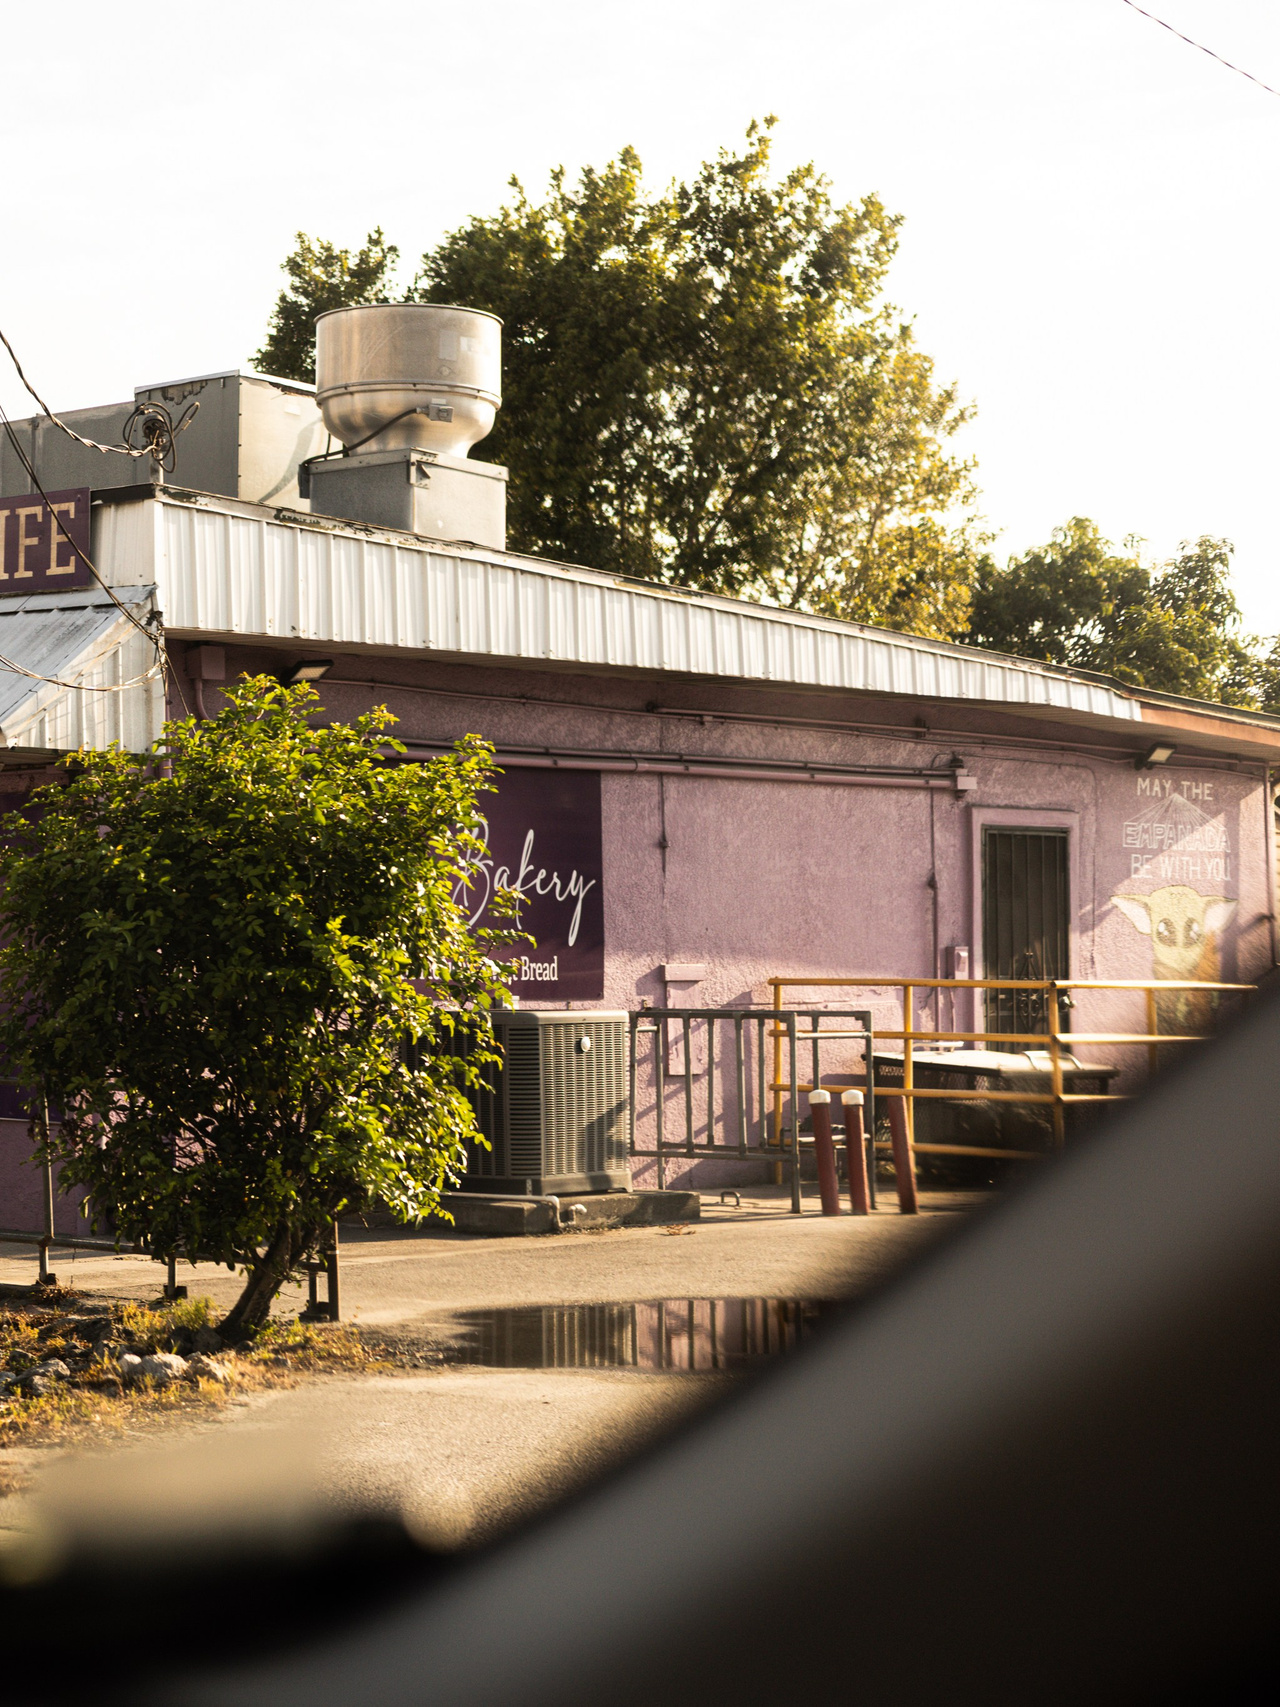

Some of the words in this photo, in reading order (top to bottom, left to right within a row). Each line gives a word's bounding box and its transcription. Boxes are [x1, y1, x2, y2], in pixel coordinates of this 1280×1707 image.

[1136, 777, 1171, 798] MAY
[1181, 781, 1213, 801] THE
[1123, 822, 1231, 853] EMPANADA
[451, 817, 596, 947] Bakery
[1131, 854, 1153, 879] BE
[1160, 855, 1201, 880] WITH
[1205, 858, 1232, 882] YOU
[521, 955, 559, 981] Bread
